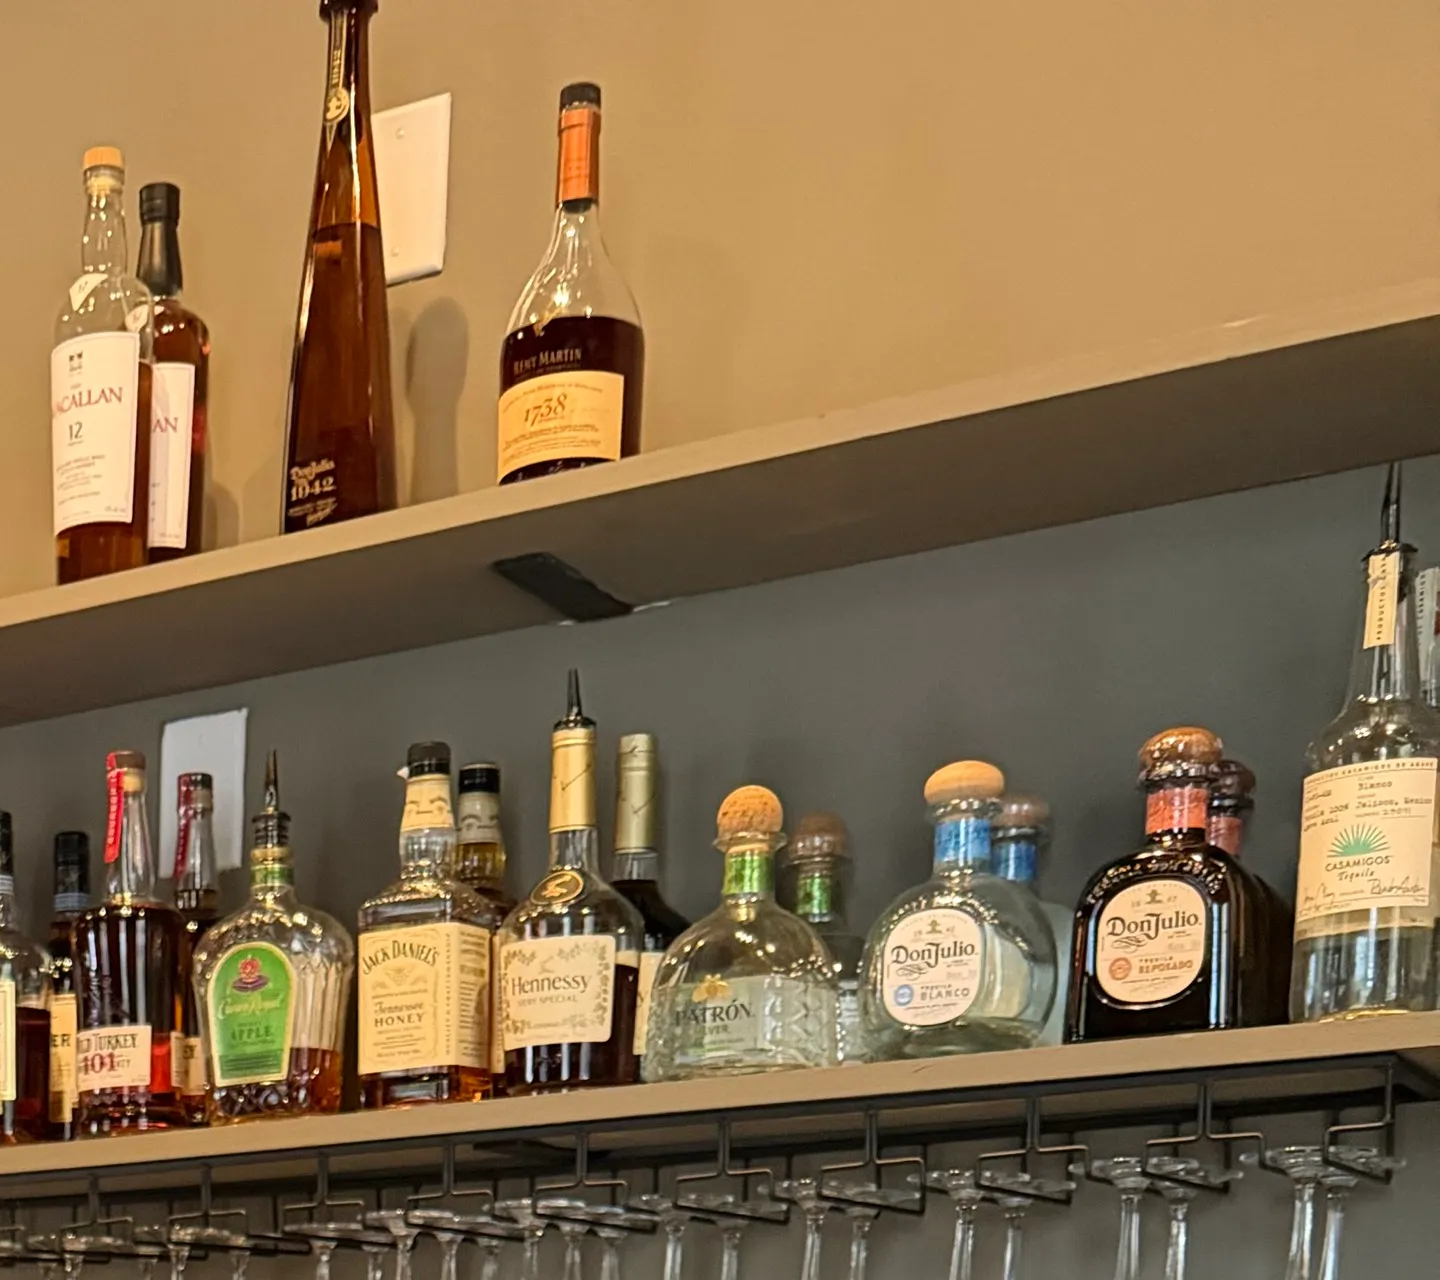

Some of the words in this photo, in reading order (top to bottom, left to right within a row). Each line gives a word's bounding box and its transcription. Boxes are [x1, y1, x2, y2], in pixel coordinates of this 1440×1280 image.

[539, 348, 582, 366] MARTIN
[524, 392, 568, 427] 1738
[68, 421, 83, 441] 12
[1325, 855, 1392, 872] CASAMIGOS
[362, 947, 392, 976] JACK
[392, 939, 440, 968] DANIEL'S
[511, 972, 591, 997] Hennessy
[920, 988, 971, 1001] BLANCO
[374, 1012, 426, 1028] HONEY
[92, 1032, 138, 1052] TURKEY
[81, 1051, 118, 1076] 101
